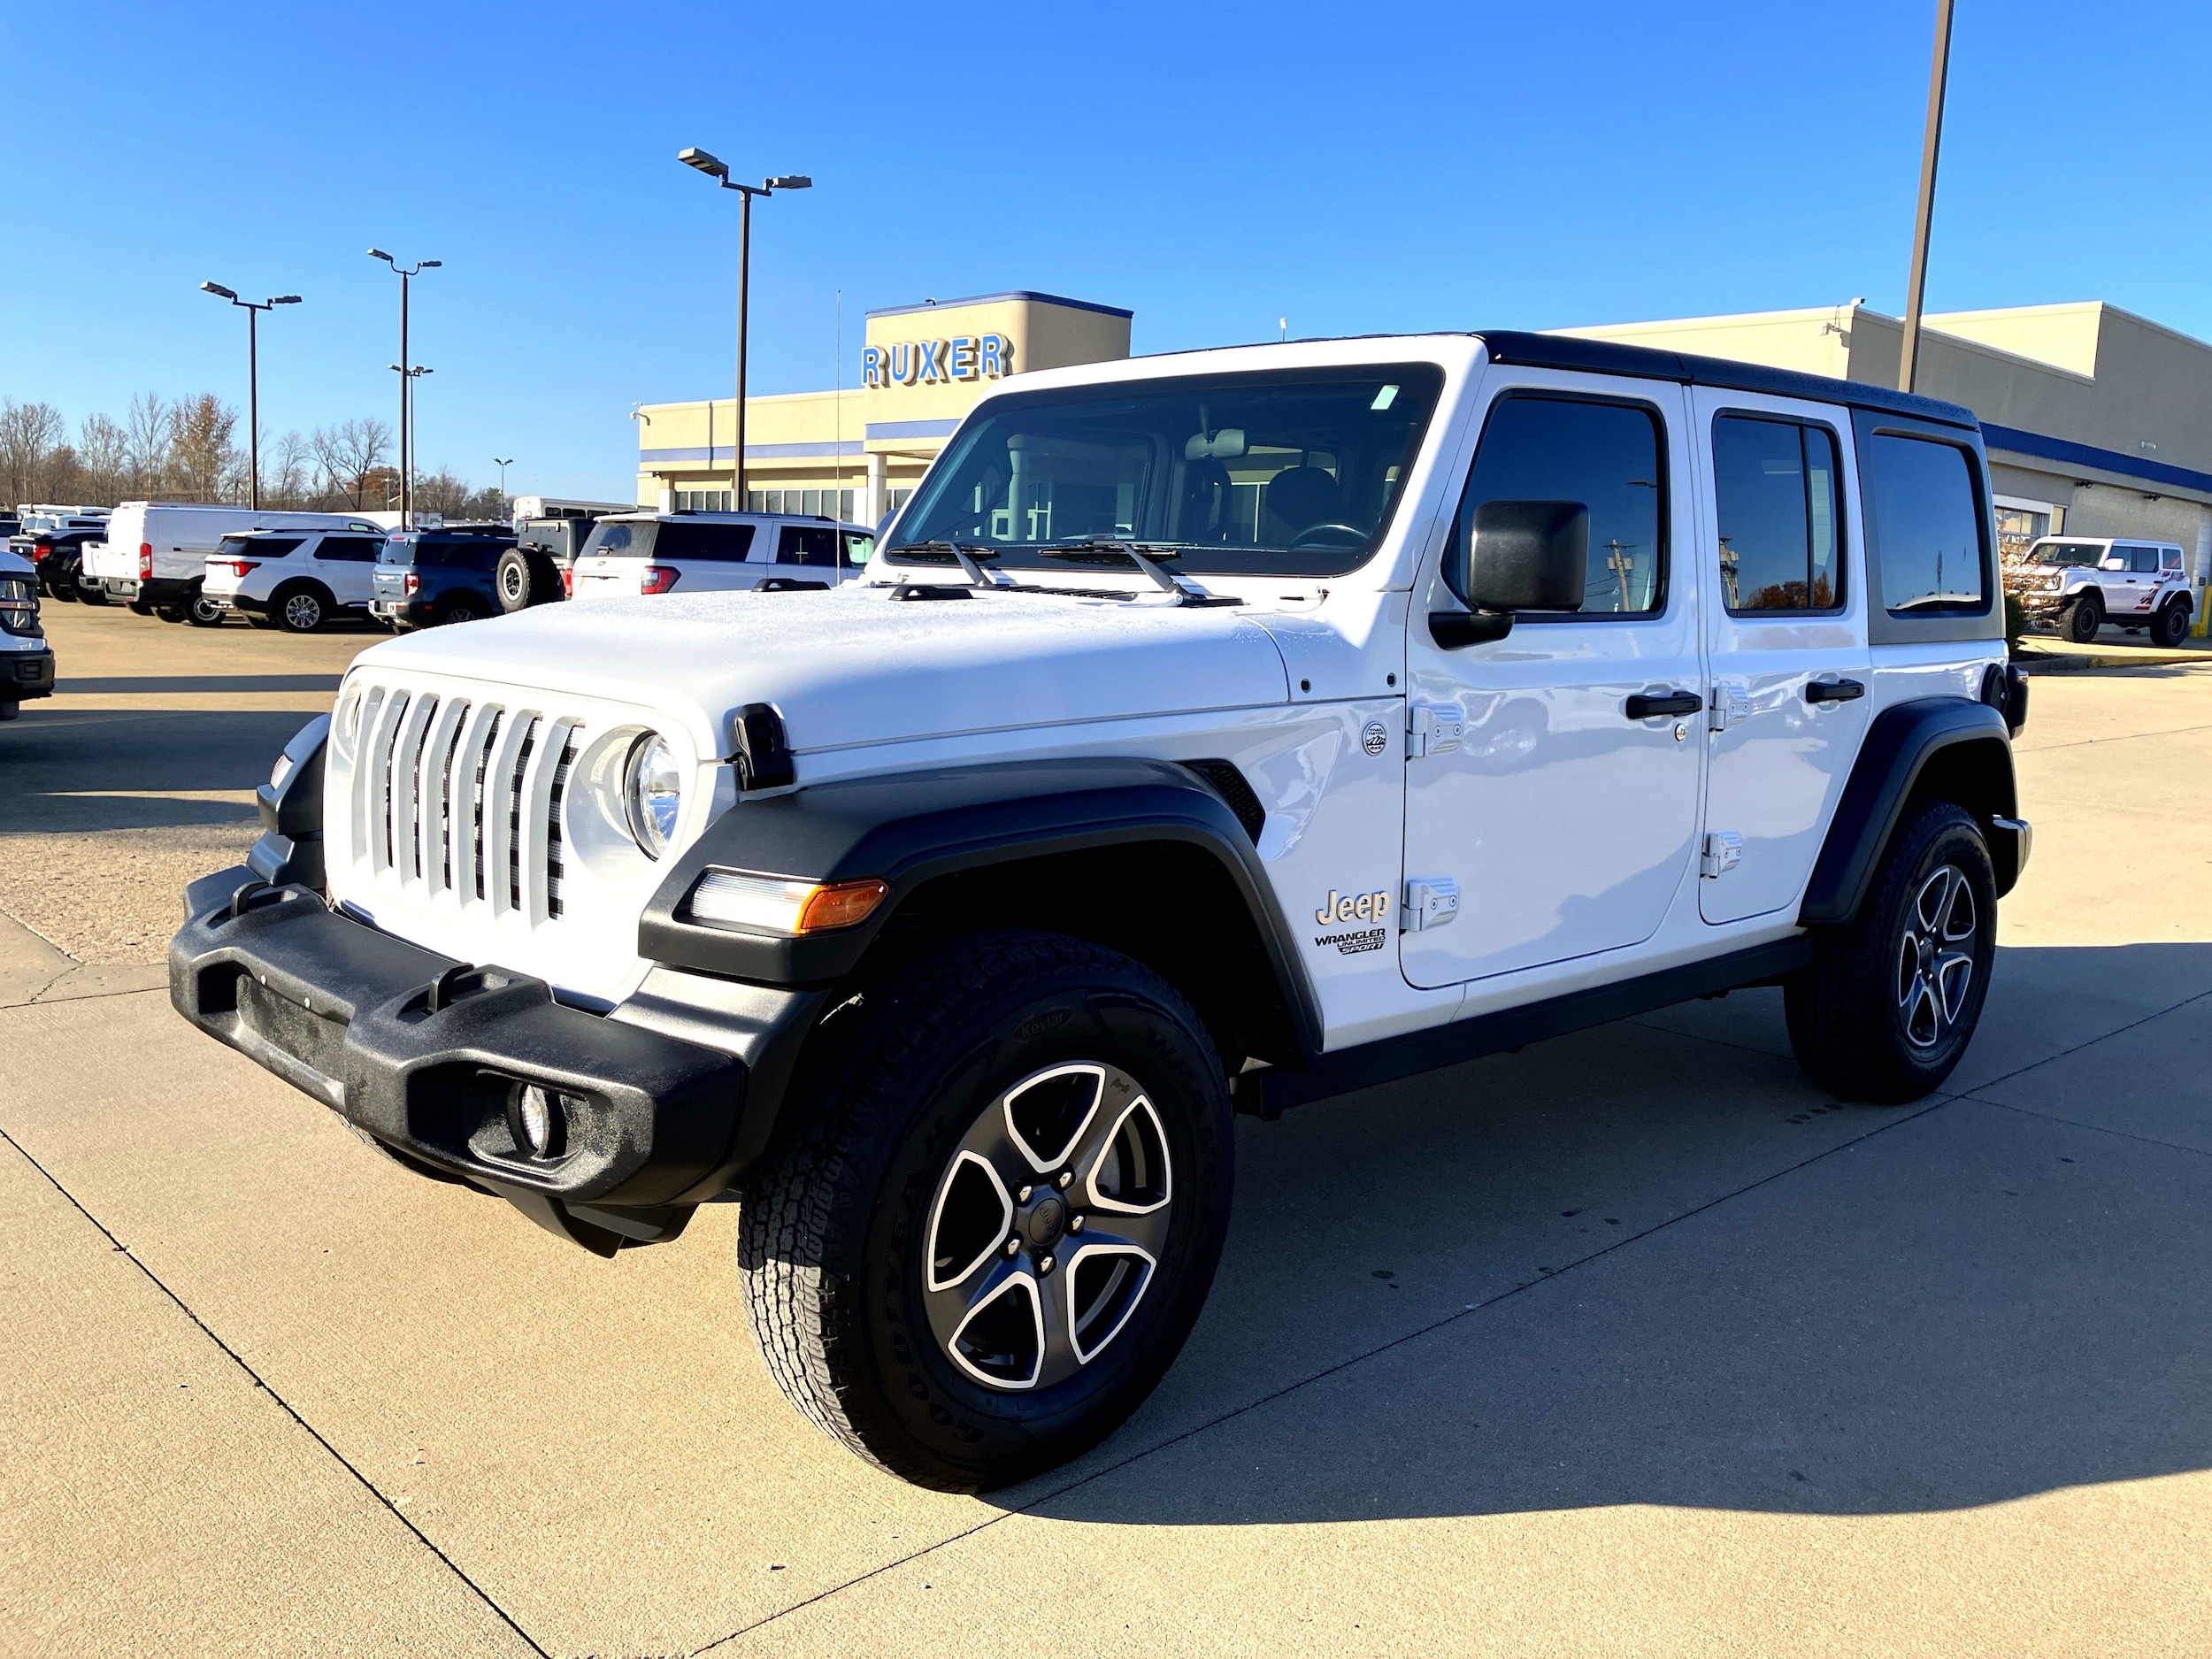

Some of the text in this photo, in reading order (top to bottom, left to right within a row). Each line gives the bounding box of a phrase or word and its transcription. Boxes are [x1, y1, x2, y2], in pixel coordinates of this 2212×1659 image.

[862, 333, 1013, 388] RUXER
[1316, 890, 1389, 925] Jeep
[1314, 928, 1386, 947] WRANGLER
[1337, 936, 1386, 948] UNLIMITED
[1340, 942, 1384, 954] SPORT
[1020, 1011, 1065, 1038] Kevlar
